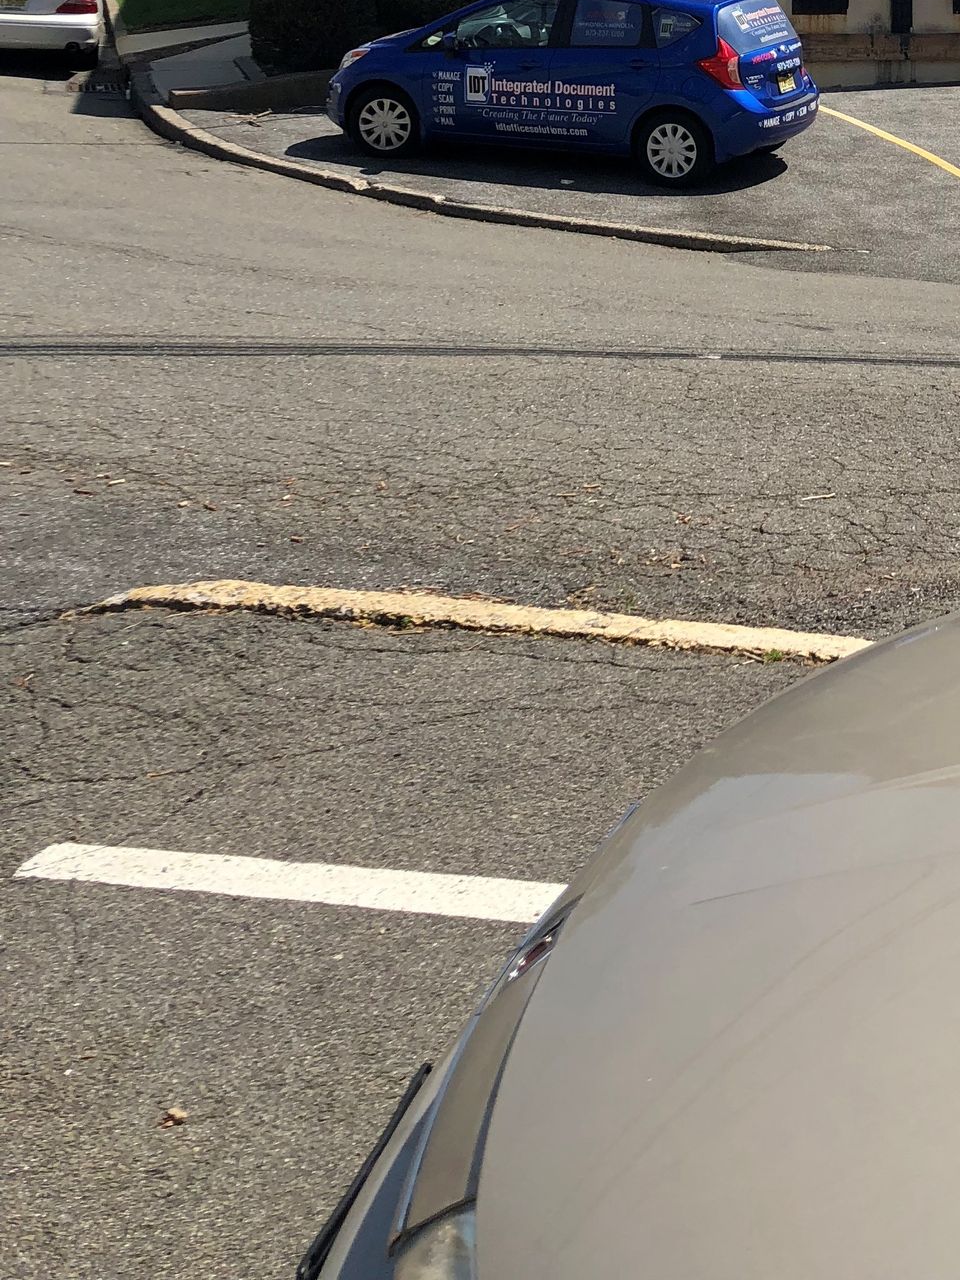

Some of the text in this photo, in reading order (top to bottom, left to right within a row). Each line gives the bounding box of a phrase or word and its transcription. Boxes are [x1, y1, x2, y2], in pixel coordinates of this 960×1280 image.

[438, 72, 461, 81] MANAGE
[437, 83, 454, 92] COPY
[468, 75, 487, 94] IDT
[491, 78, 616, 97] Integrated Document
[438, 95, 454, 103] SCAN
[491, 94, 616, 110] Technologies
[439, 106, 456, 115] PRINT
[477, 108, 519, 121] "Creating
[521, 111, 538, 120] The
[540, 112, 569, 121] Future
[440, 118, 455, 126] MAIL
[495, 122, 588, 136] idtofficesolutions.com
